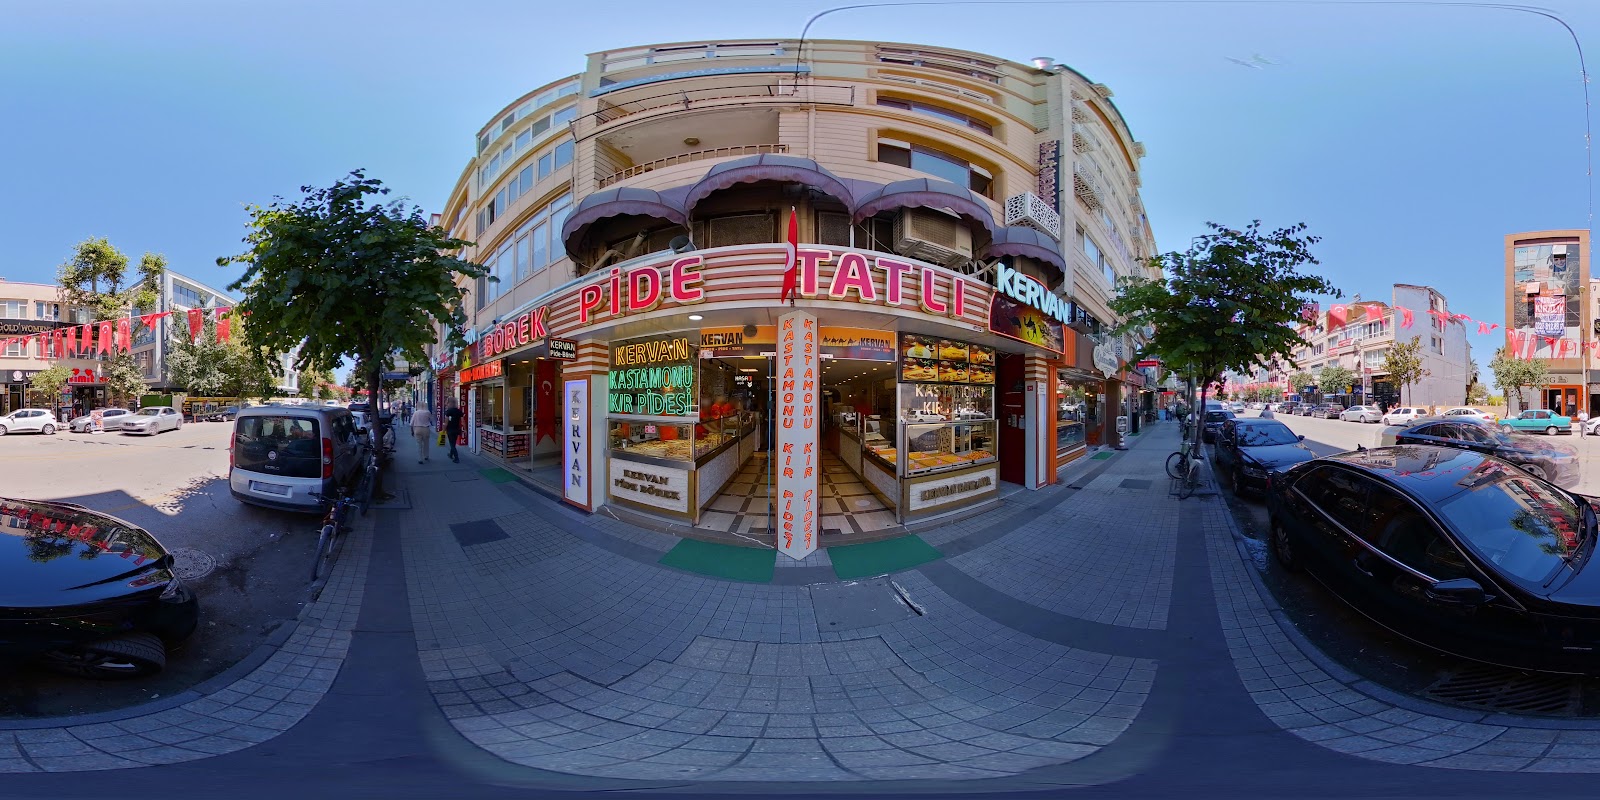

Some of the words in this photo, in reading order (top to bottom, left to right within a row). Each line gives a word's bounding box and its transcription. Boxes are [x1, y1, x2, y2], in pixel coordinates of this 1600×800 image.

[580, 256, 703, 324] PİDE
[787, 248, 965, 317] TATLI
[997, 262, 1072, 325] KERVAN
[484, 305, 547, 357] BÖREK
[550, 339, 576, 351] KERVAN
[702, 333, 742, 345] KERVAN
[860, 337, 891, 348] KERVAN
[615, 338, 688, 366] KERVAN
[609, 366, 693, 389] KASTAMONU
[783, 318, 795, 429] KASTAMONU
[803, 318, 814, 429] KASTAMONU
[609, 393, 634, 413] KIR
[637, 388, 692, 415] PİDESİ
[571, 390, 582, 487] KERVAN
[623, 469, 669, 486] KERVAN
[783, 443, 794, 479] KIR
[803, 442, 813, 479] KIR
[614, 478, 638, 492] PİDE
[639, 484, 681, 500] BÖREK
